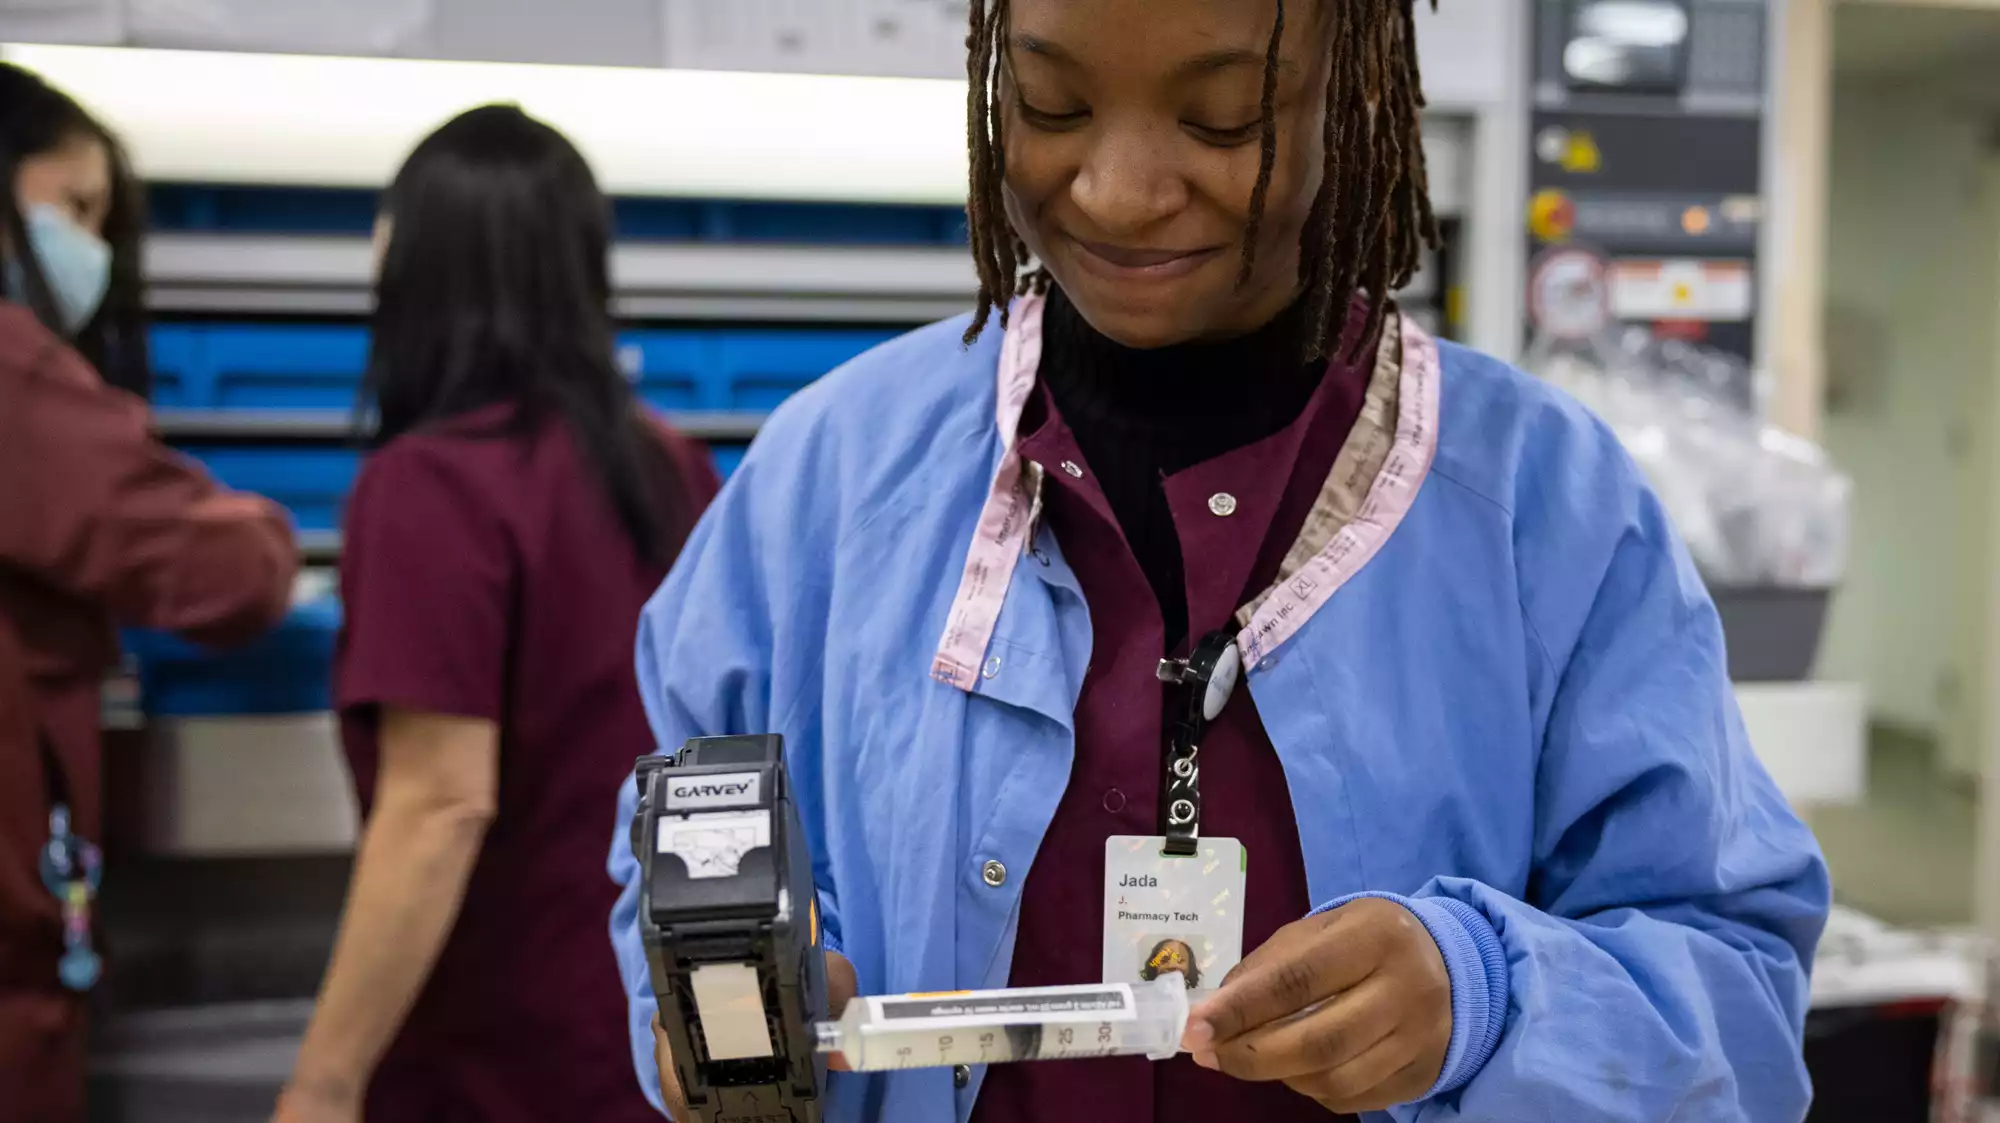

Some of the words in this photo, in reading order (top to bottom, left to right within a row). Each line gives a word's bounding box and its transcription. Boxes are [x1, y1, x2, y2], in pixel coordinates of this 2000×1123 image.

[1296, 580, 1312, 596] XL
[673, 783, 749, 798] GARVEY
[1118, 873, 1158, 888] Jada
[1117, 895, 1128, 905] J.
[1117, 911, 1171, 924] Pharmacy
[1173, 911, 1199, 922] Tech
[980, 1032, 995, 1050] 15
[1059, 1027, 1074, 1044] 25
[939, 1035, 954, 1052] 10
